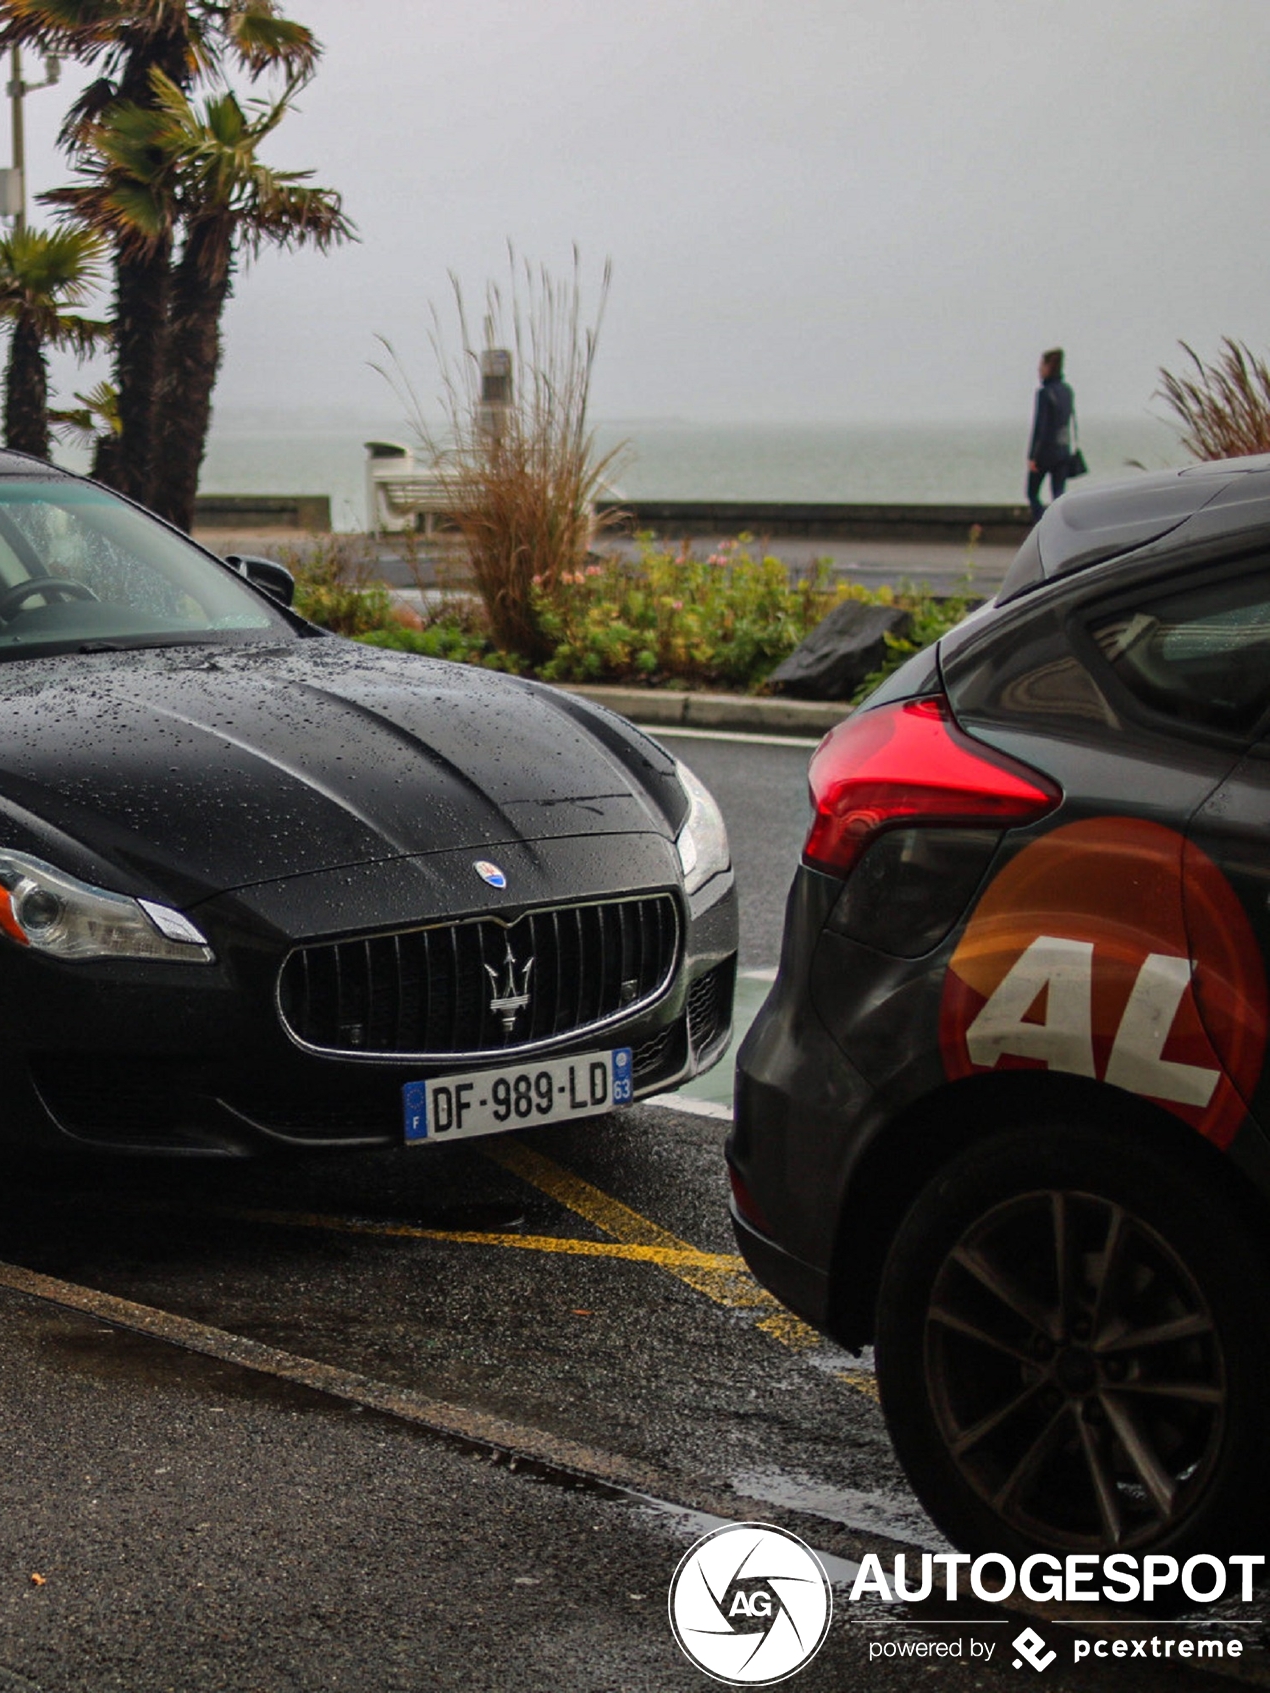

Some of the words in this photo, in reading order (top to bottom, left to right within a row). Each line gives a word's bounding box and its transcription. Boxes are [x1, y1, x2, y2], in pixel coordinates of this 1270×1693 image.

[966, 935, 1221, 1108] AL
[432, 1061, 608, 1133] DF-989-LD
[614, 1079, 630, 1100] 63
[413, 1116, 420, 1130] F
